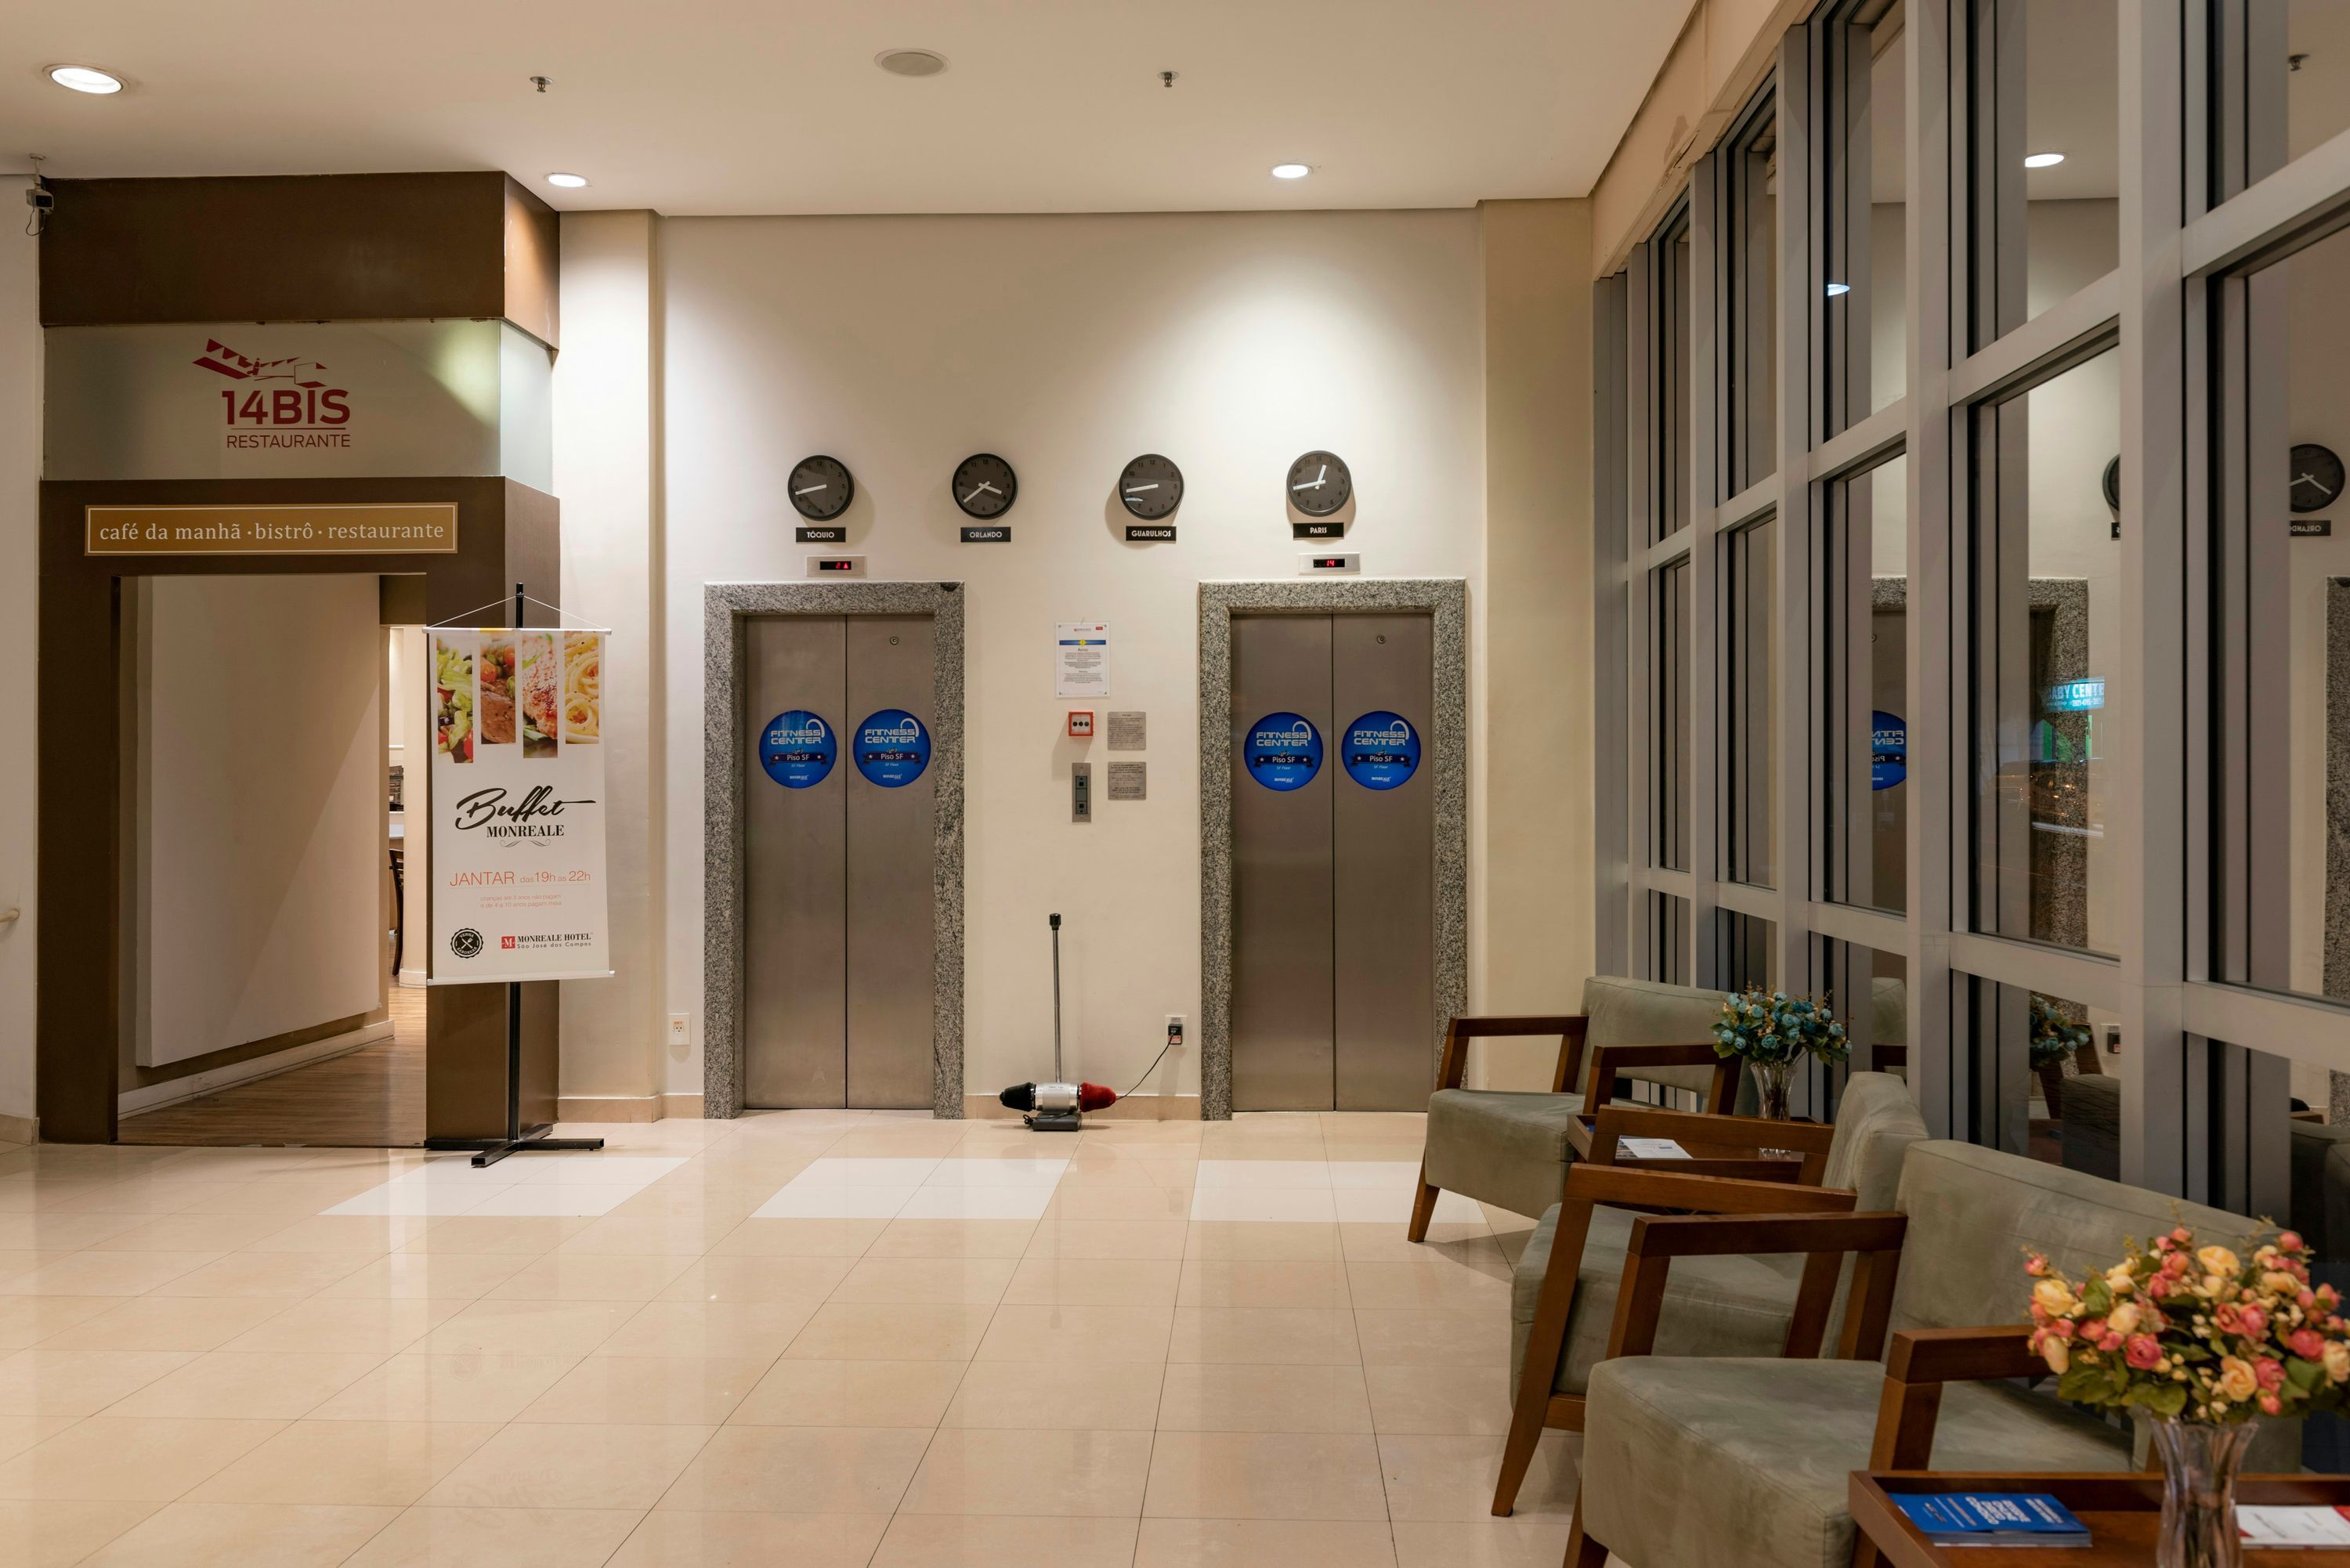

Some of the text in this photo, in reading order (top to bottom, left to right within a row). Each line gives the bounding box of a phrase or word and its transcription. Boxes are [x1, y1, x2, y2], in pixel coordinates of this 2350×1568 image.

[221, 388, 351, 425] 14BIS
[226, 433, 351, 449] RESTAURANTE
[99, 522, 444, 540] café da manhã bistrô restaurante
[806, 529, 835, 539] TÓQUIO
[1131, 529, 1172, 538] GUARULHOS
[1310, 526, 1328, 535] PARIS
[455, 786, 597, 830] Buffet
[486, 825, 565, 837] MONREALE
[450, 871, 515, 887] JANTAR
[534, 871, 555, 883] 19h
[569, 870, 591, 881] 22h
